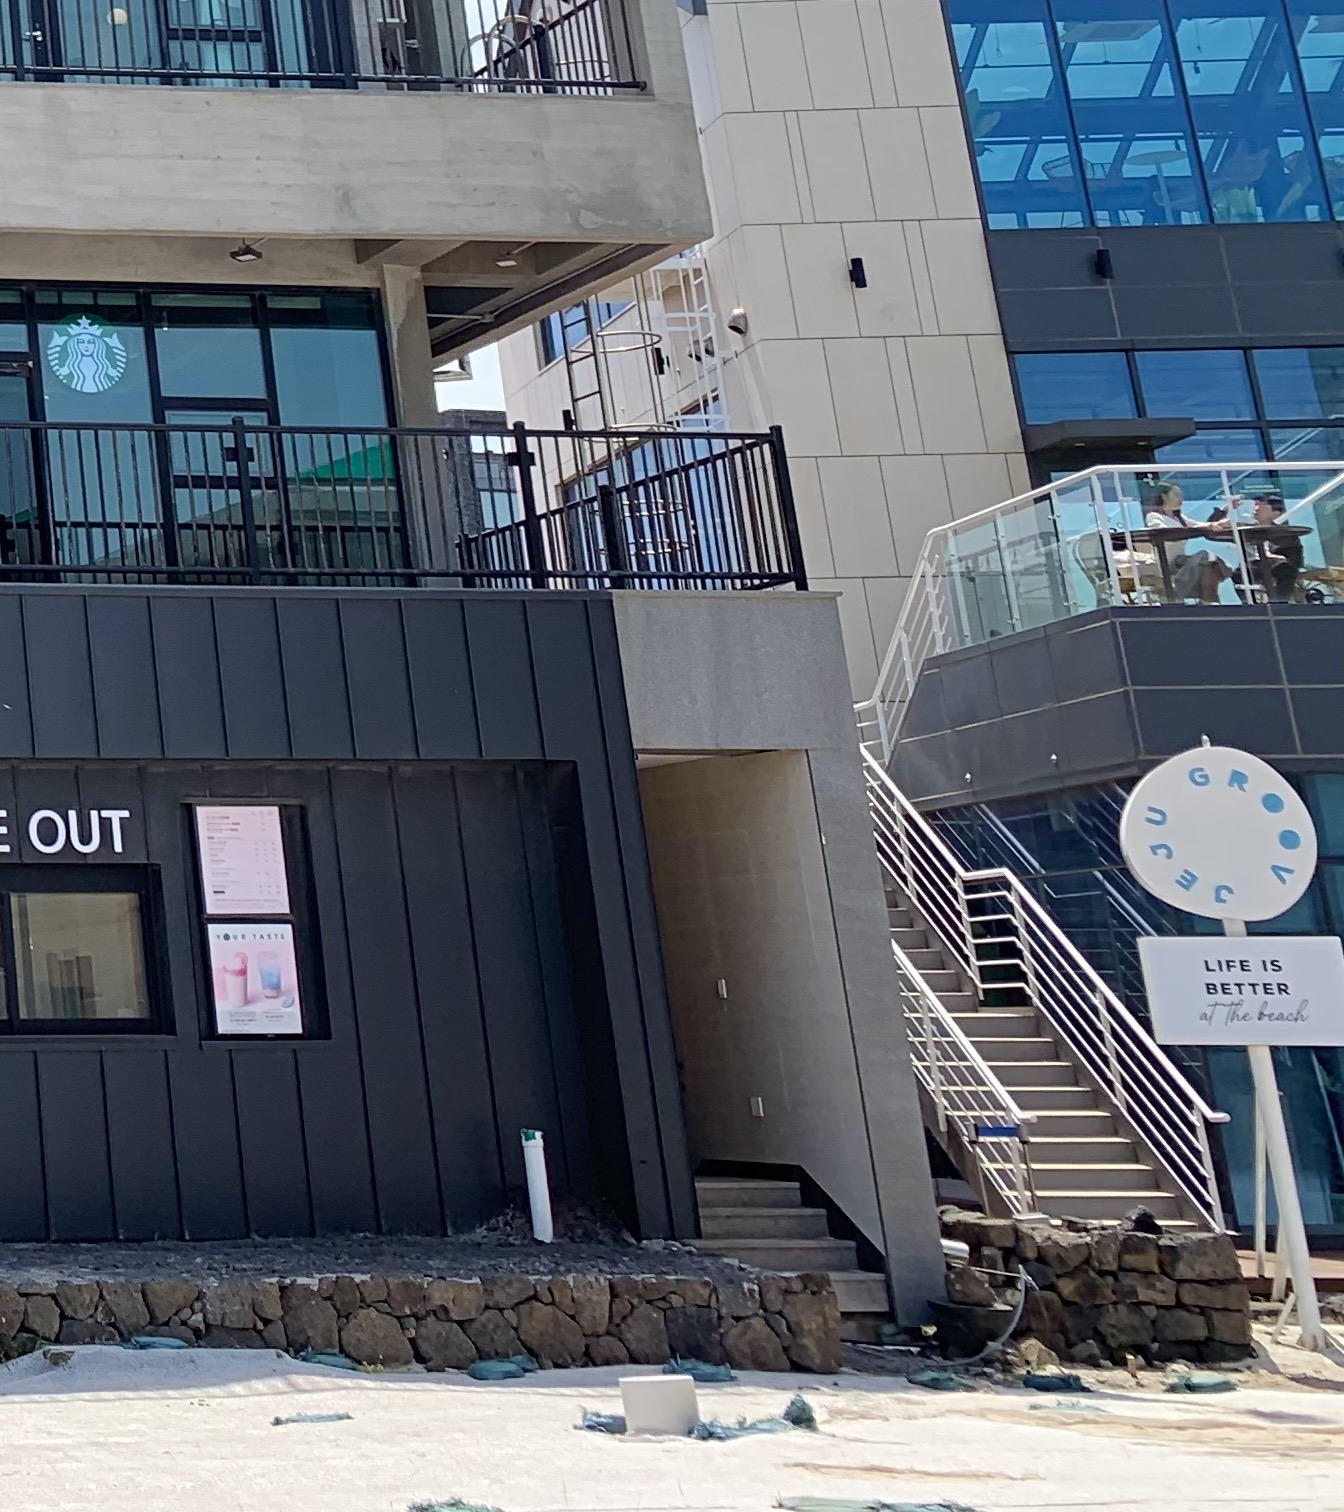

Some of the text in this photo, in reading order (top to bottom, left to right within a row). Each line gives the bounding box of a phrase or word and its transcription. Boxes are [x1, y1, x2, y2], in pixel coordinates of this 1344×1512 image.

[28, 808, 131, 854] OUT
[252, 933, 285, 941] TASTE
[1204, 959, 1283, 973] LIFE IS
[1204, 982, 1291, 996] BETTER
[1199, 1000, 1221, 1027] at
[1257, 999, 1310, 1024] beach
